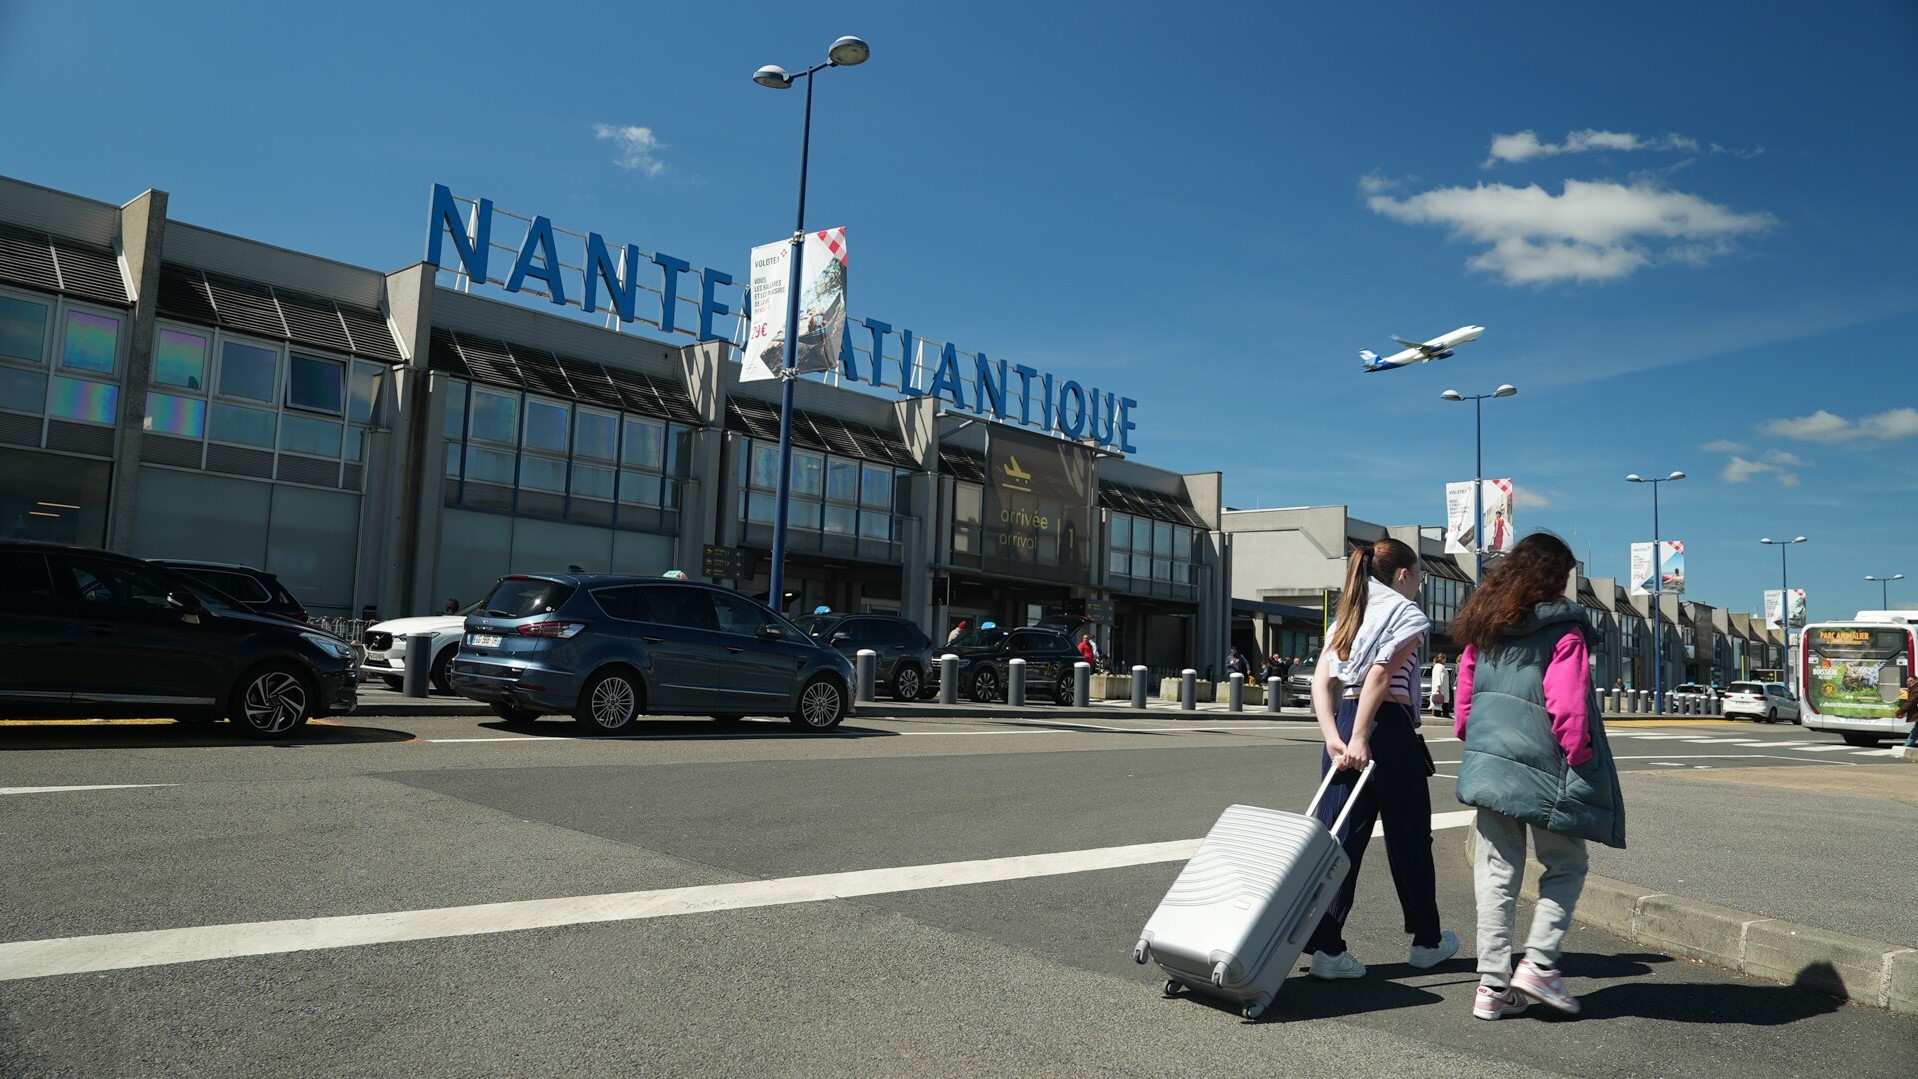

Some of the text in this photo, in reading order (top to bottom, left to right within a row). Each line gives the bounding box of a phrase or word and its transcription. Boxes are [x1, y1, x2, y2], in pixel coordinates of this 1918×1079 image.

[424, 183, 752, 352] NANTE
[1000, 508, 1048, 530] arrivée
[999, 531, 1037, 551] arrival
[1819, 632, 1870, 640] PARC ANIMALIER
